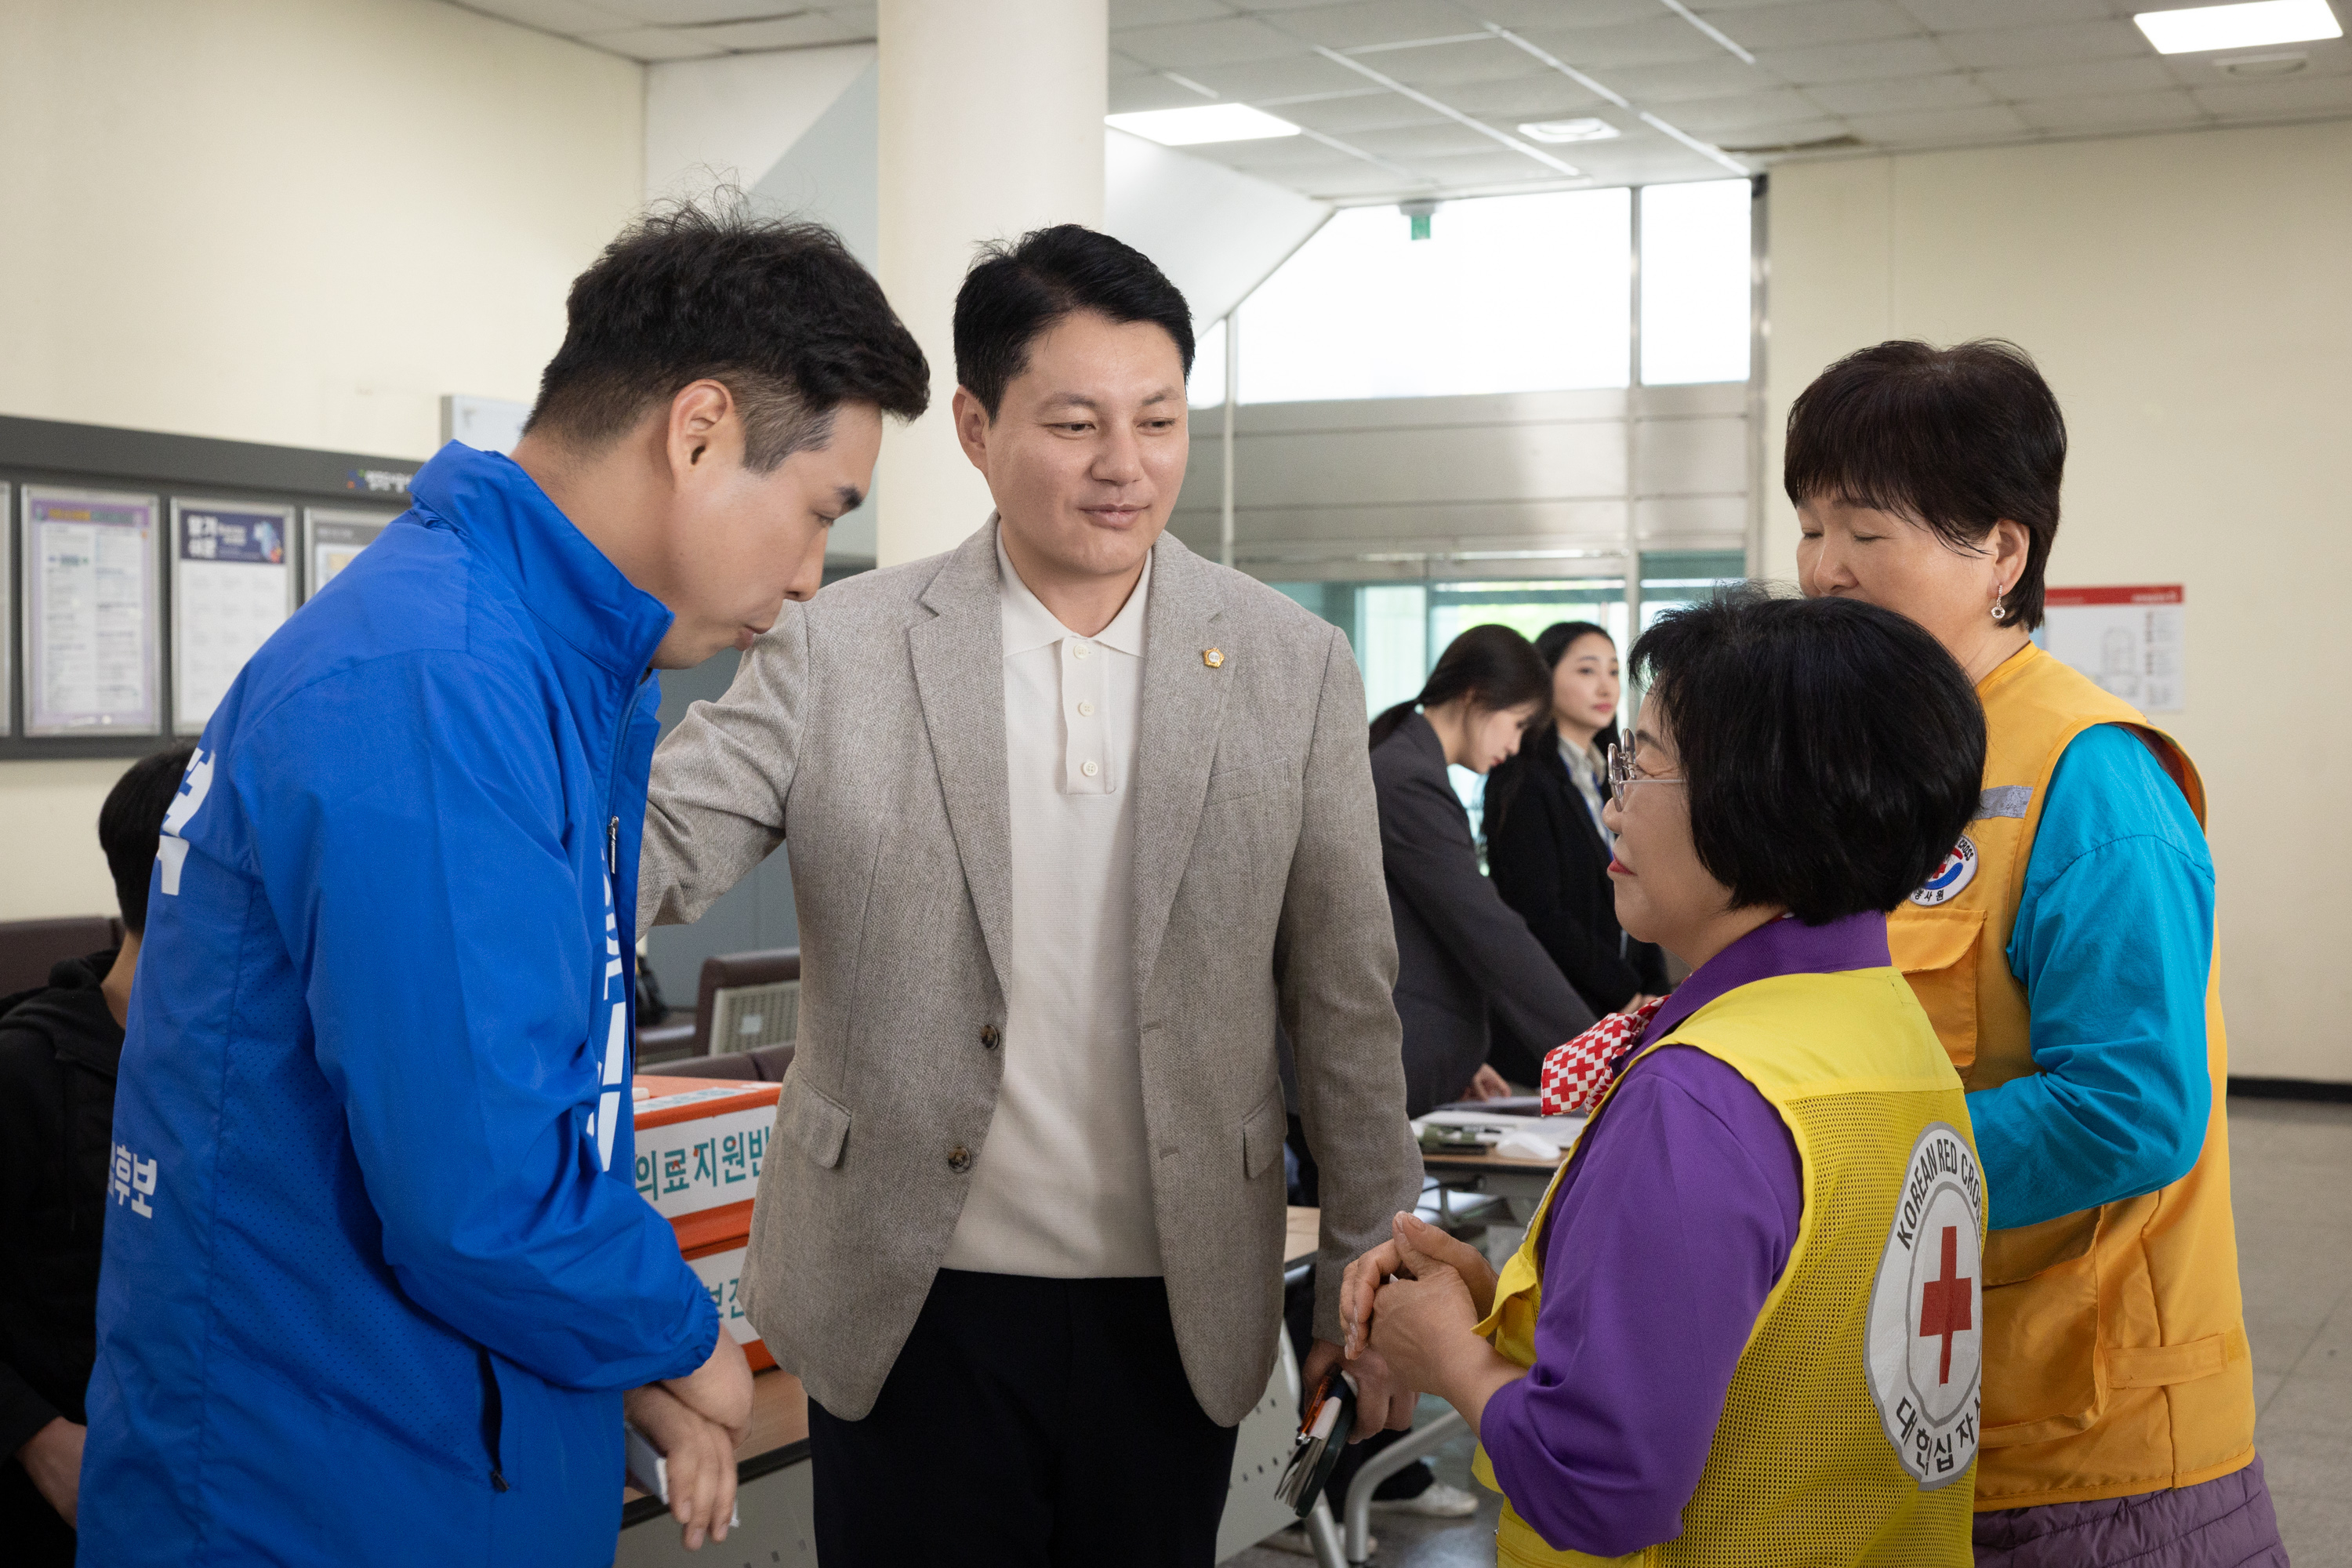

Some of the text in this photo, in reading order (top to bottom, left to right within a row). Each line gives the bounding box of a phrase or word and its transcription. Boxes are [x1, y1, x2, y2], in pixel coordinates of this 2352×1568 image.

[1958, 839, 1973, 861] CROSS
[1896, 1138, 1982, 1251] KOREAN RED CROS
